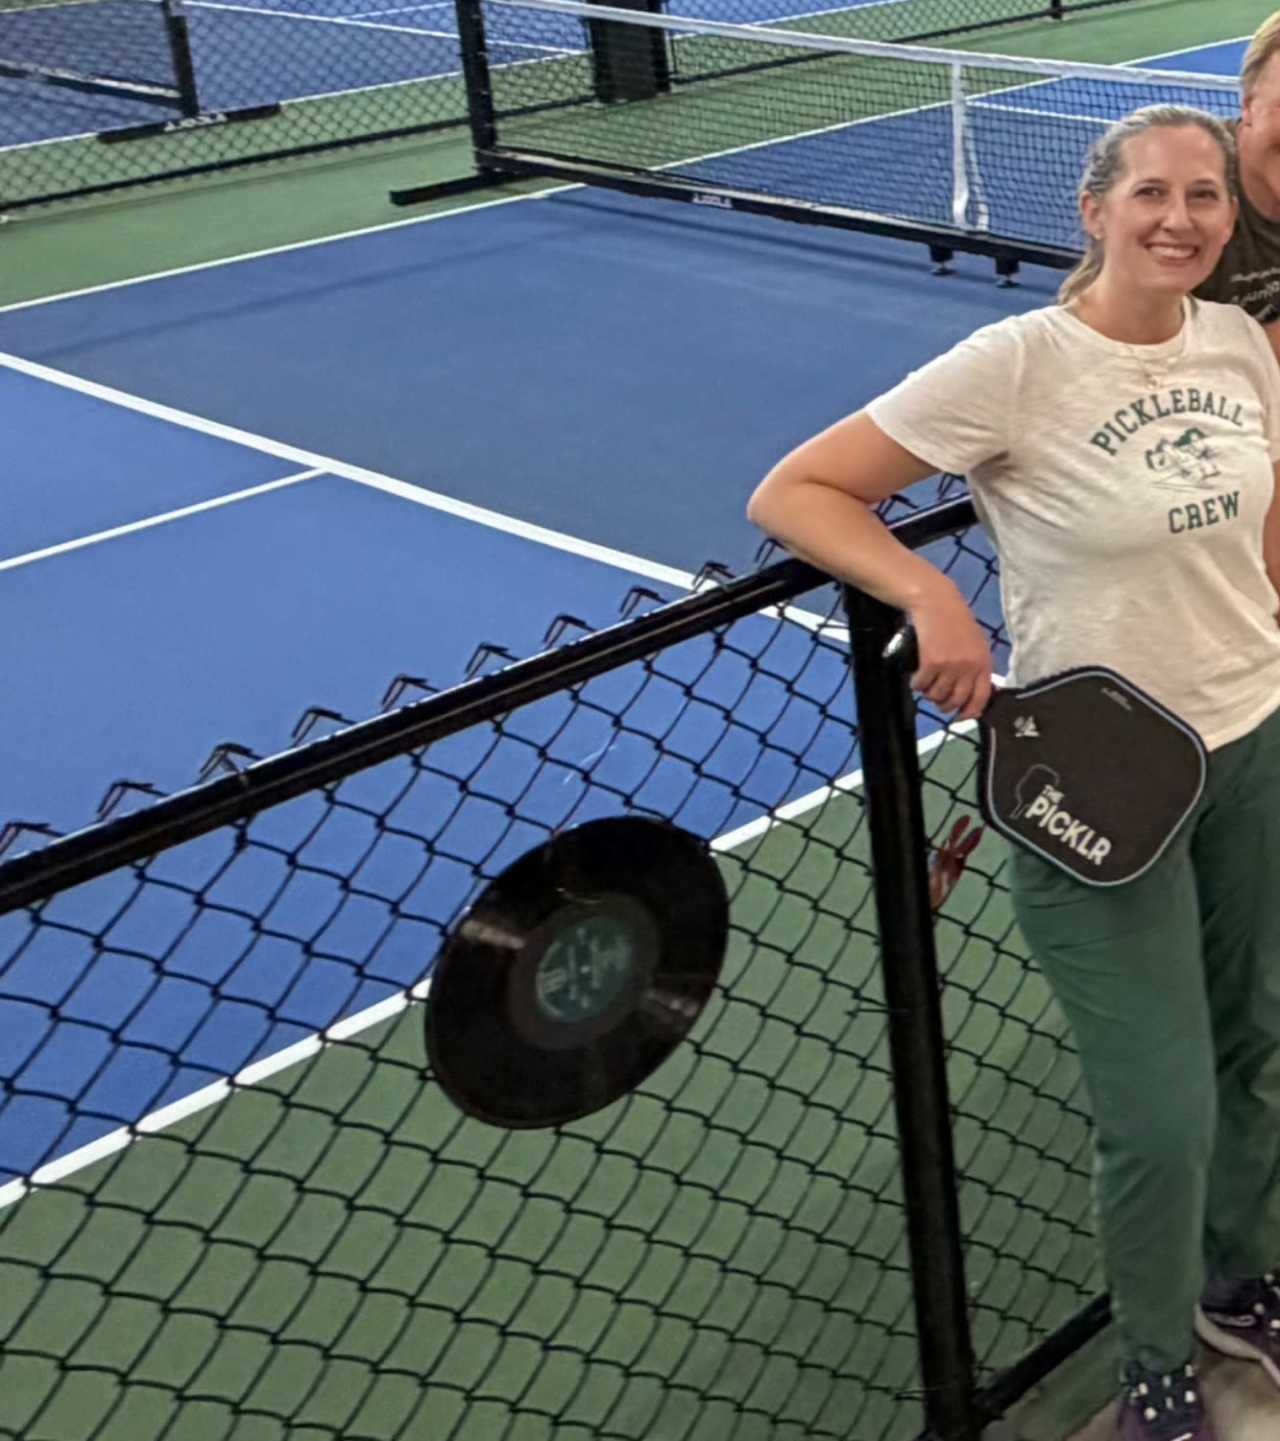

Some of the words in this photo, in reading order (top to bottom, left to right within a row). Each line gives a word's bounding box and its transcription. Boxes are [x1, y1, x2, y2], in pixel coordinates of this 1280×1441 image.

[1090, 388, 1244, 457] PICKLEBALL
[1168, 491, 1241, 535] CREW
[1025, 794, 1112, 866] PICKLR
